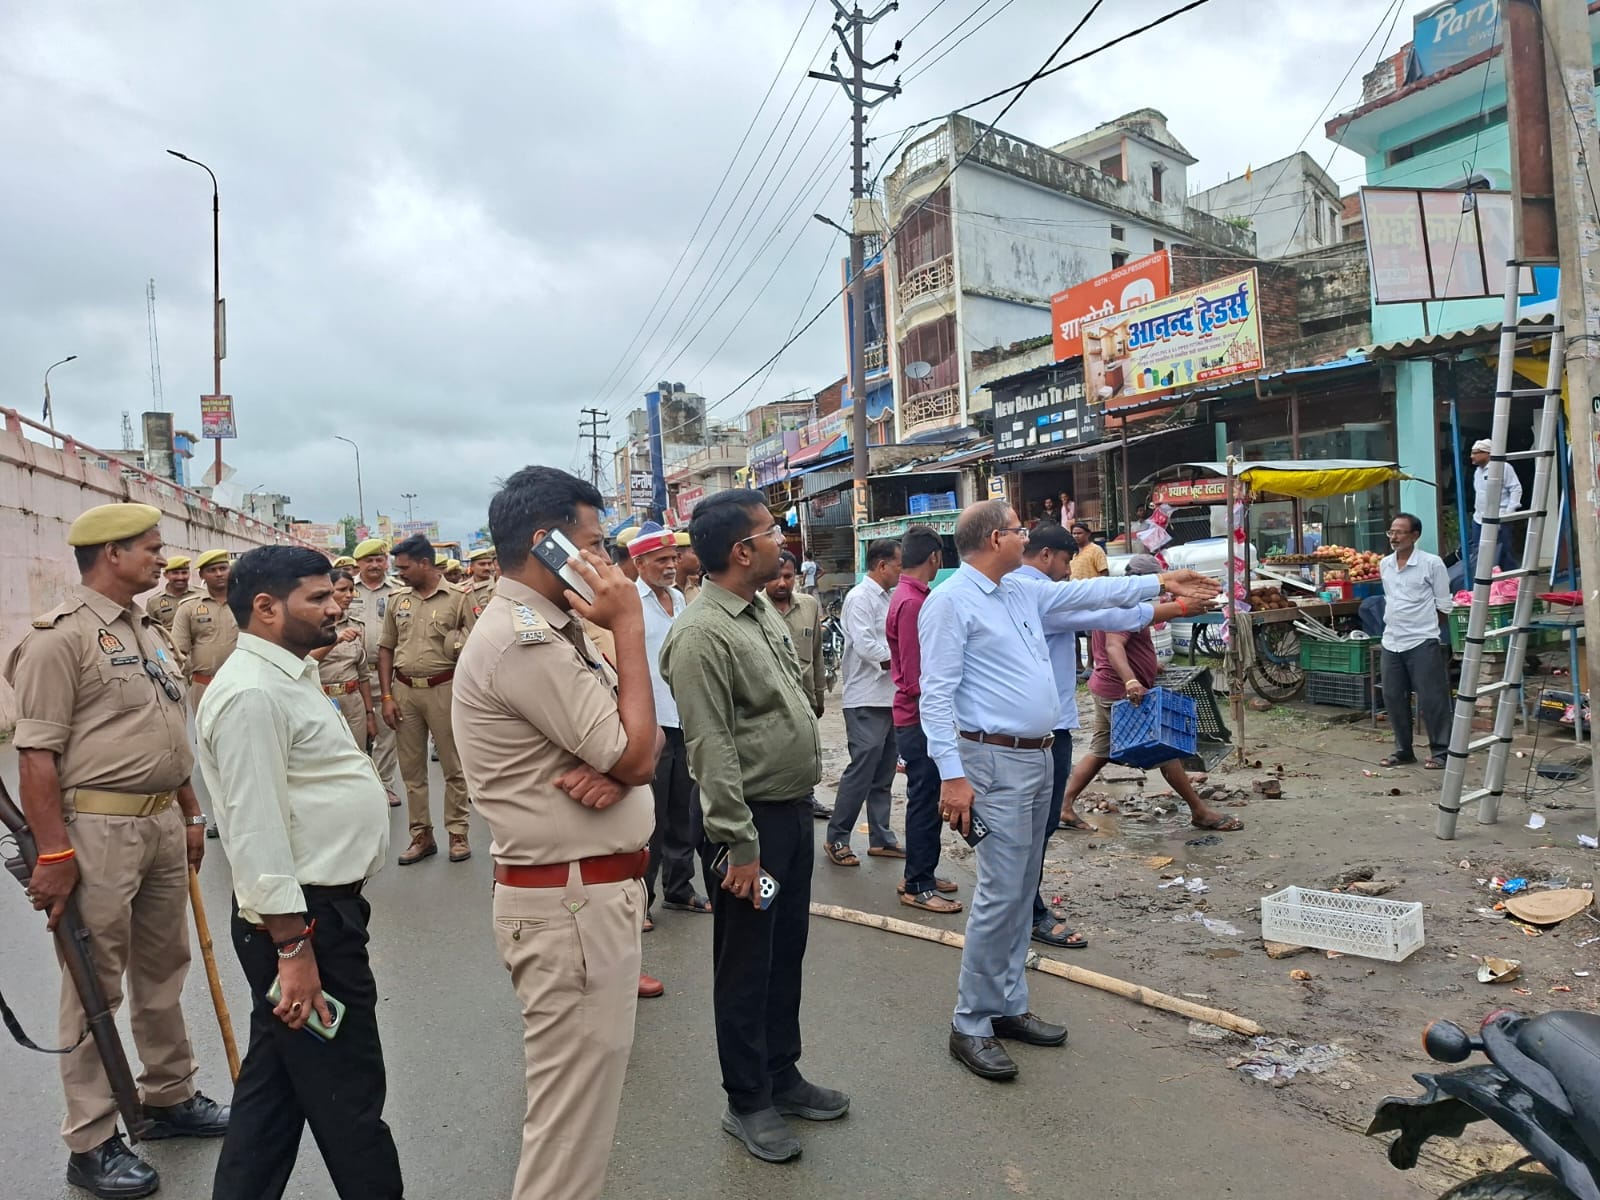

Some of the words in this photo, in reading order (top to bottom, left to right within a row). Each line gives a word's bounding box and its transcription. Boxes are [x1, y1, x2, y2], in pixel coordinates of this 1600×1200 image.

[1128, 306, 1195, 349] आनन्द
[1196, 282, 1249, 336] ट्रेडर्स
[995, 401, 1015, 418] NEW
[1015, 392, 1049, 413] BALAJI
[1048, 382, 1086, 405] TRADER
